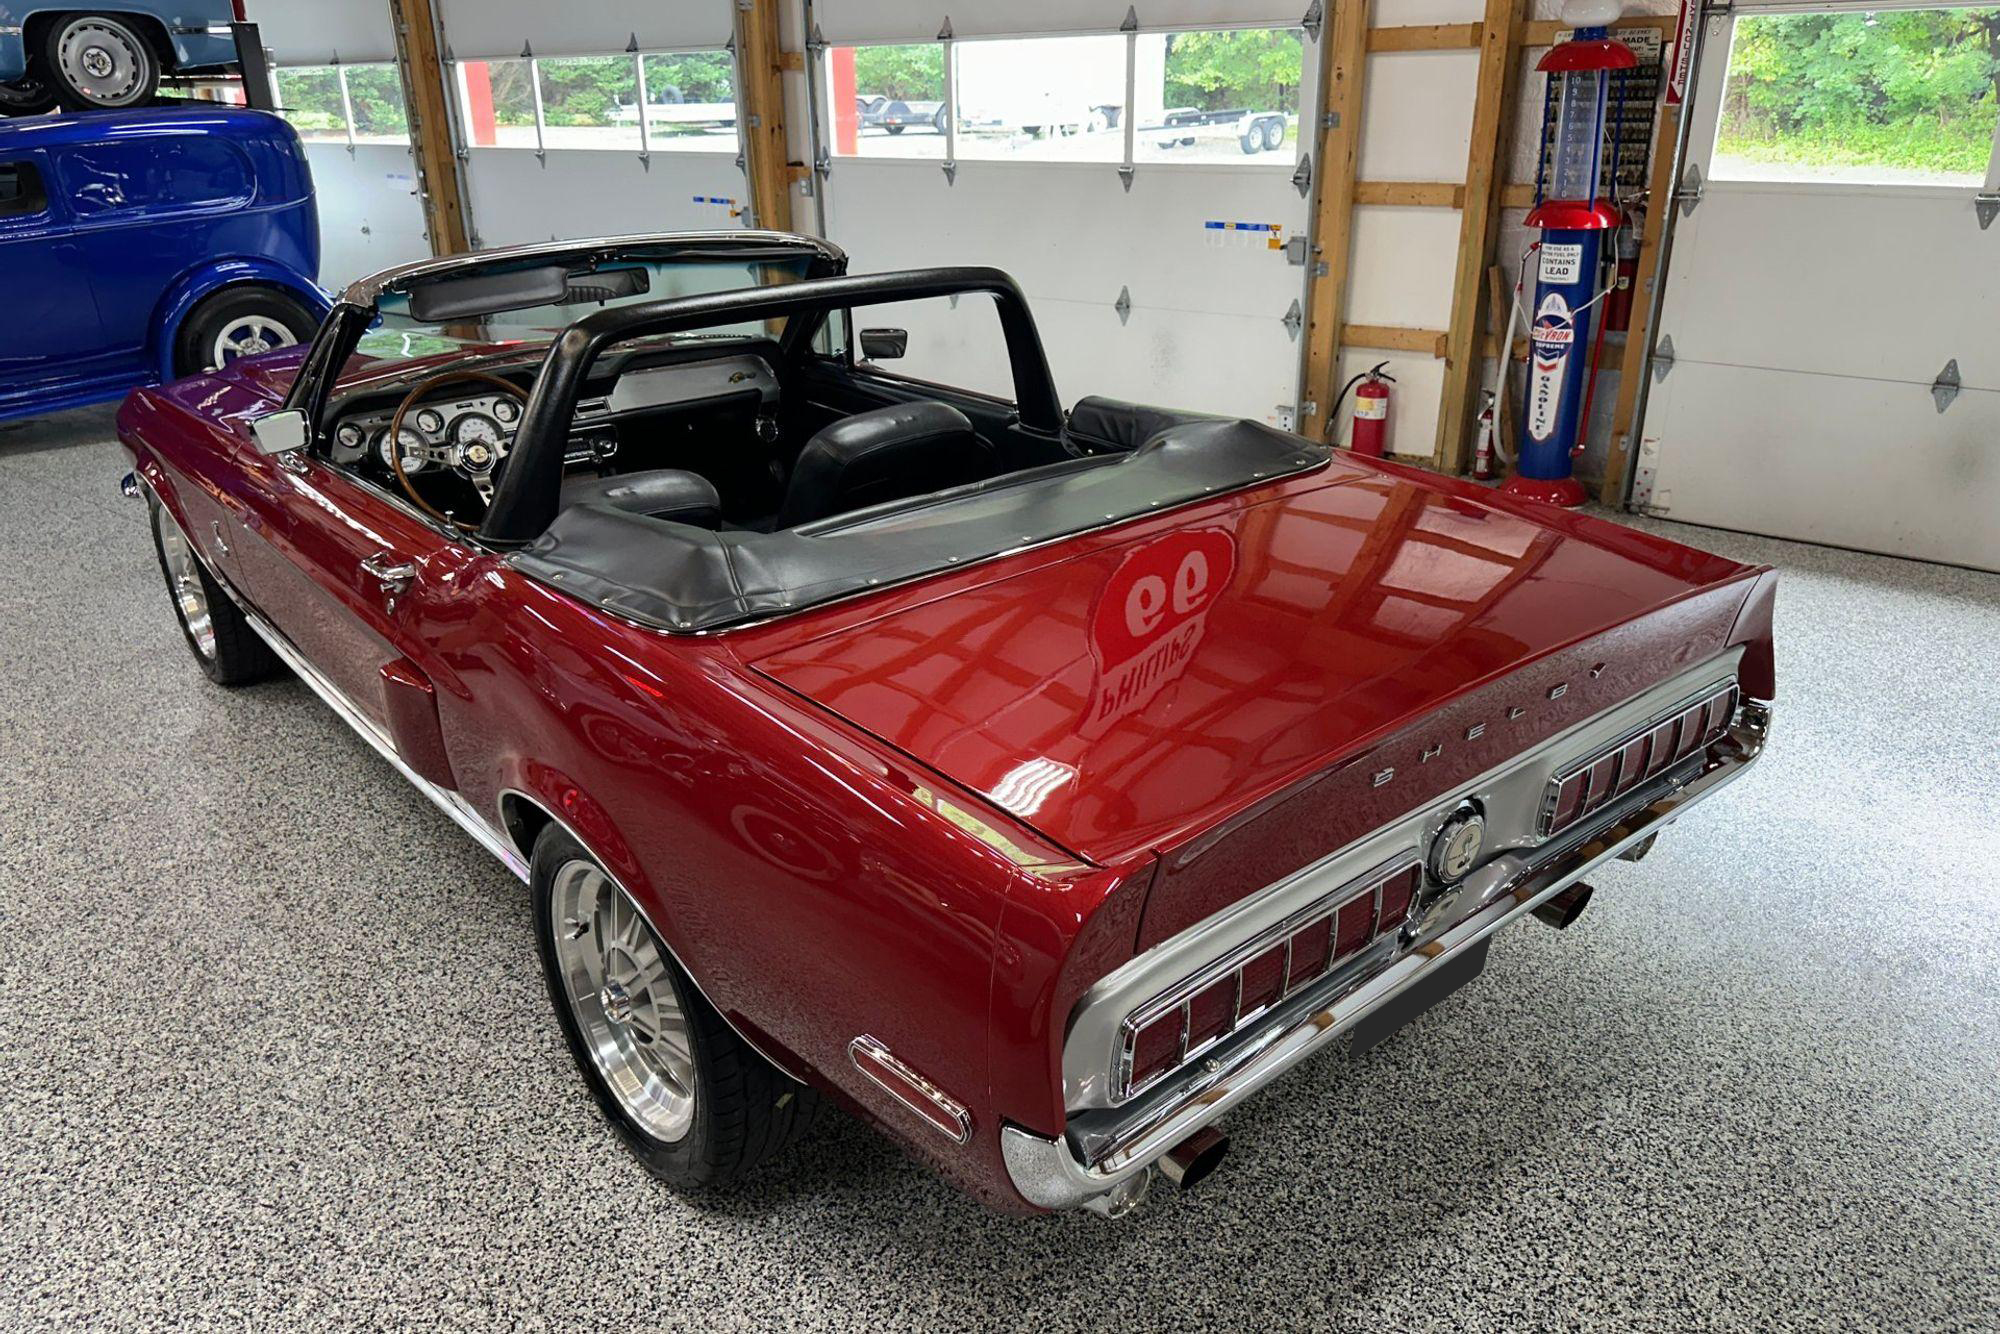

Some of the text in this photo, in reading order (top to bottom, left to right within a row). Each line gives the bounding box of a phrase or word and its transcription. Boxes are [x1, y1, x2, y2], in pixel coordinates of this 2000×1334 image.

[1570, 76, 1581, 85] 10
[1572, 88, 1578, 96] 9
[1570, 99, 1576, 108] 8
[1569, 111, 1575, 119] 7
[1568, 122, 1574, 131] 6
[1567, 134, 1573, 142] 5
[1564, 157, 1570, 165] 3
[1563, 168, 1569, 176] 2
[1563, 179, 1567, 187] 1
[1561, 190, 1567, 198] 0
[1542, 257, 1576, 266] CONTAINS
[1545, 266, 1569, 275] LEAD
[1535, 375, 1550, 431] GASOLINE
[1373, 662, 1606, 787] SHELBY
